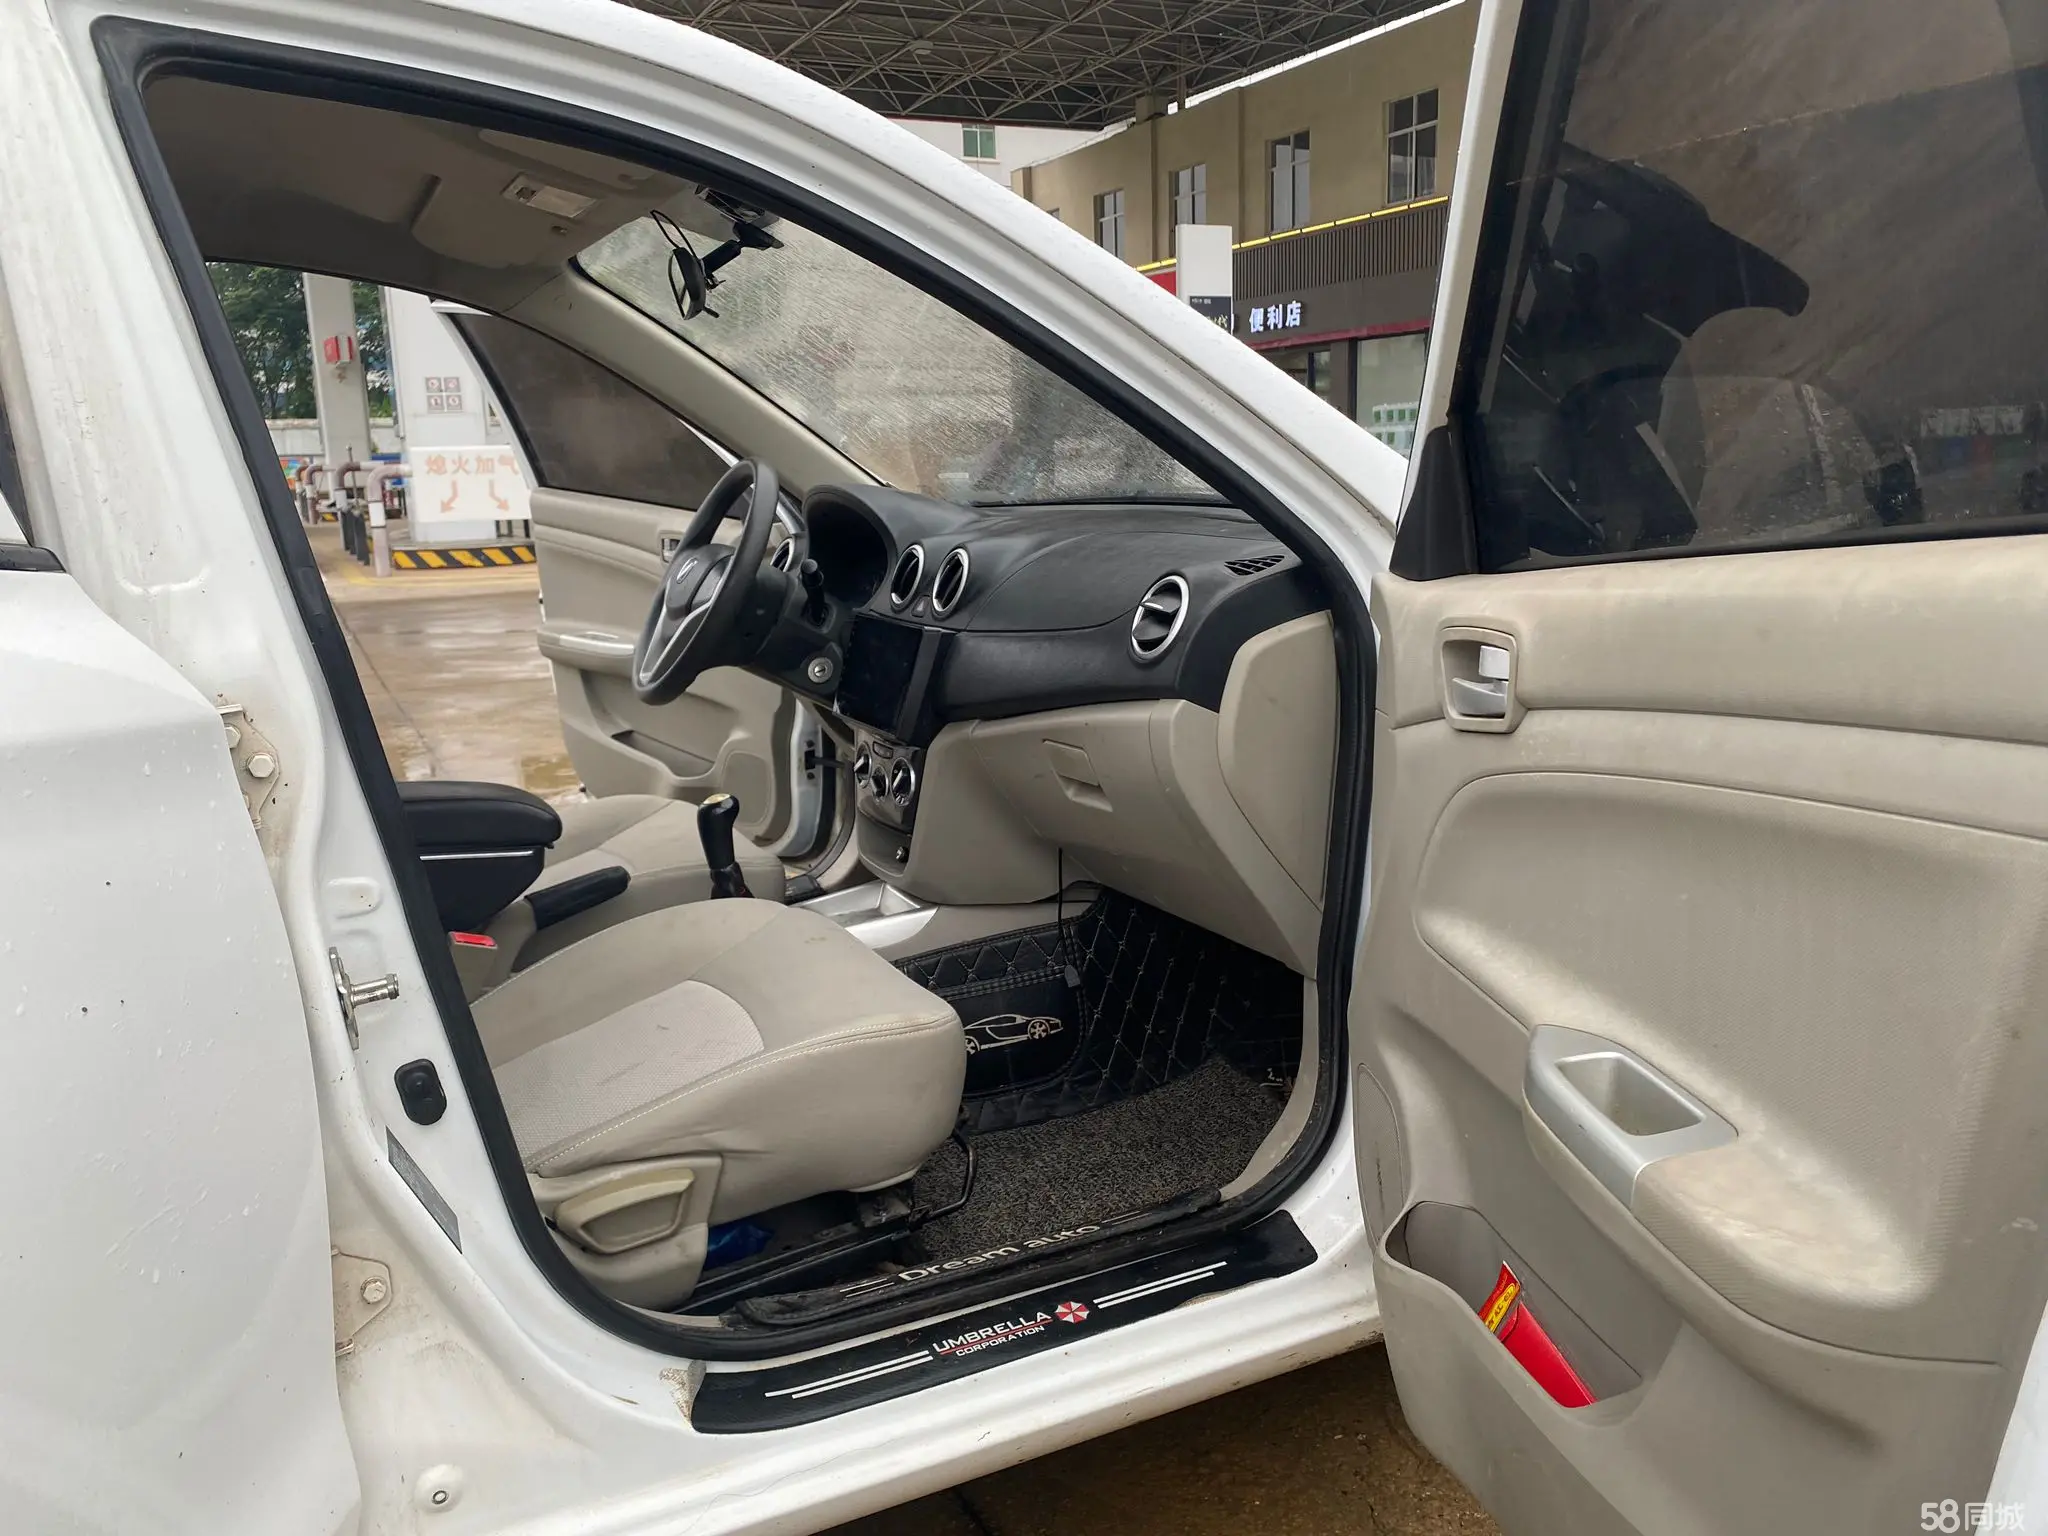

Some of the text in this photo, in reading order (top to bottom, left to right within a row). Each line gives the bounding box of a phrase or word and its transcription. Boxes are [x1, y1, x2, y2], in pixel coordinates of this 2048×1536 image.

[1249, 300, 1302, 333] 便利店
[424, 453, 519, 475] 熄火加气
[898, 1224, 1100, 1281] Dream auto
[932, 1311, 1052, 1352] UMBRELLA
[955, 1325, 1045, 1357] CORPORATION
